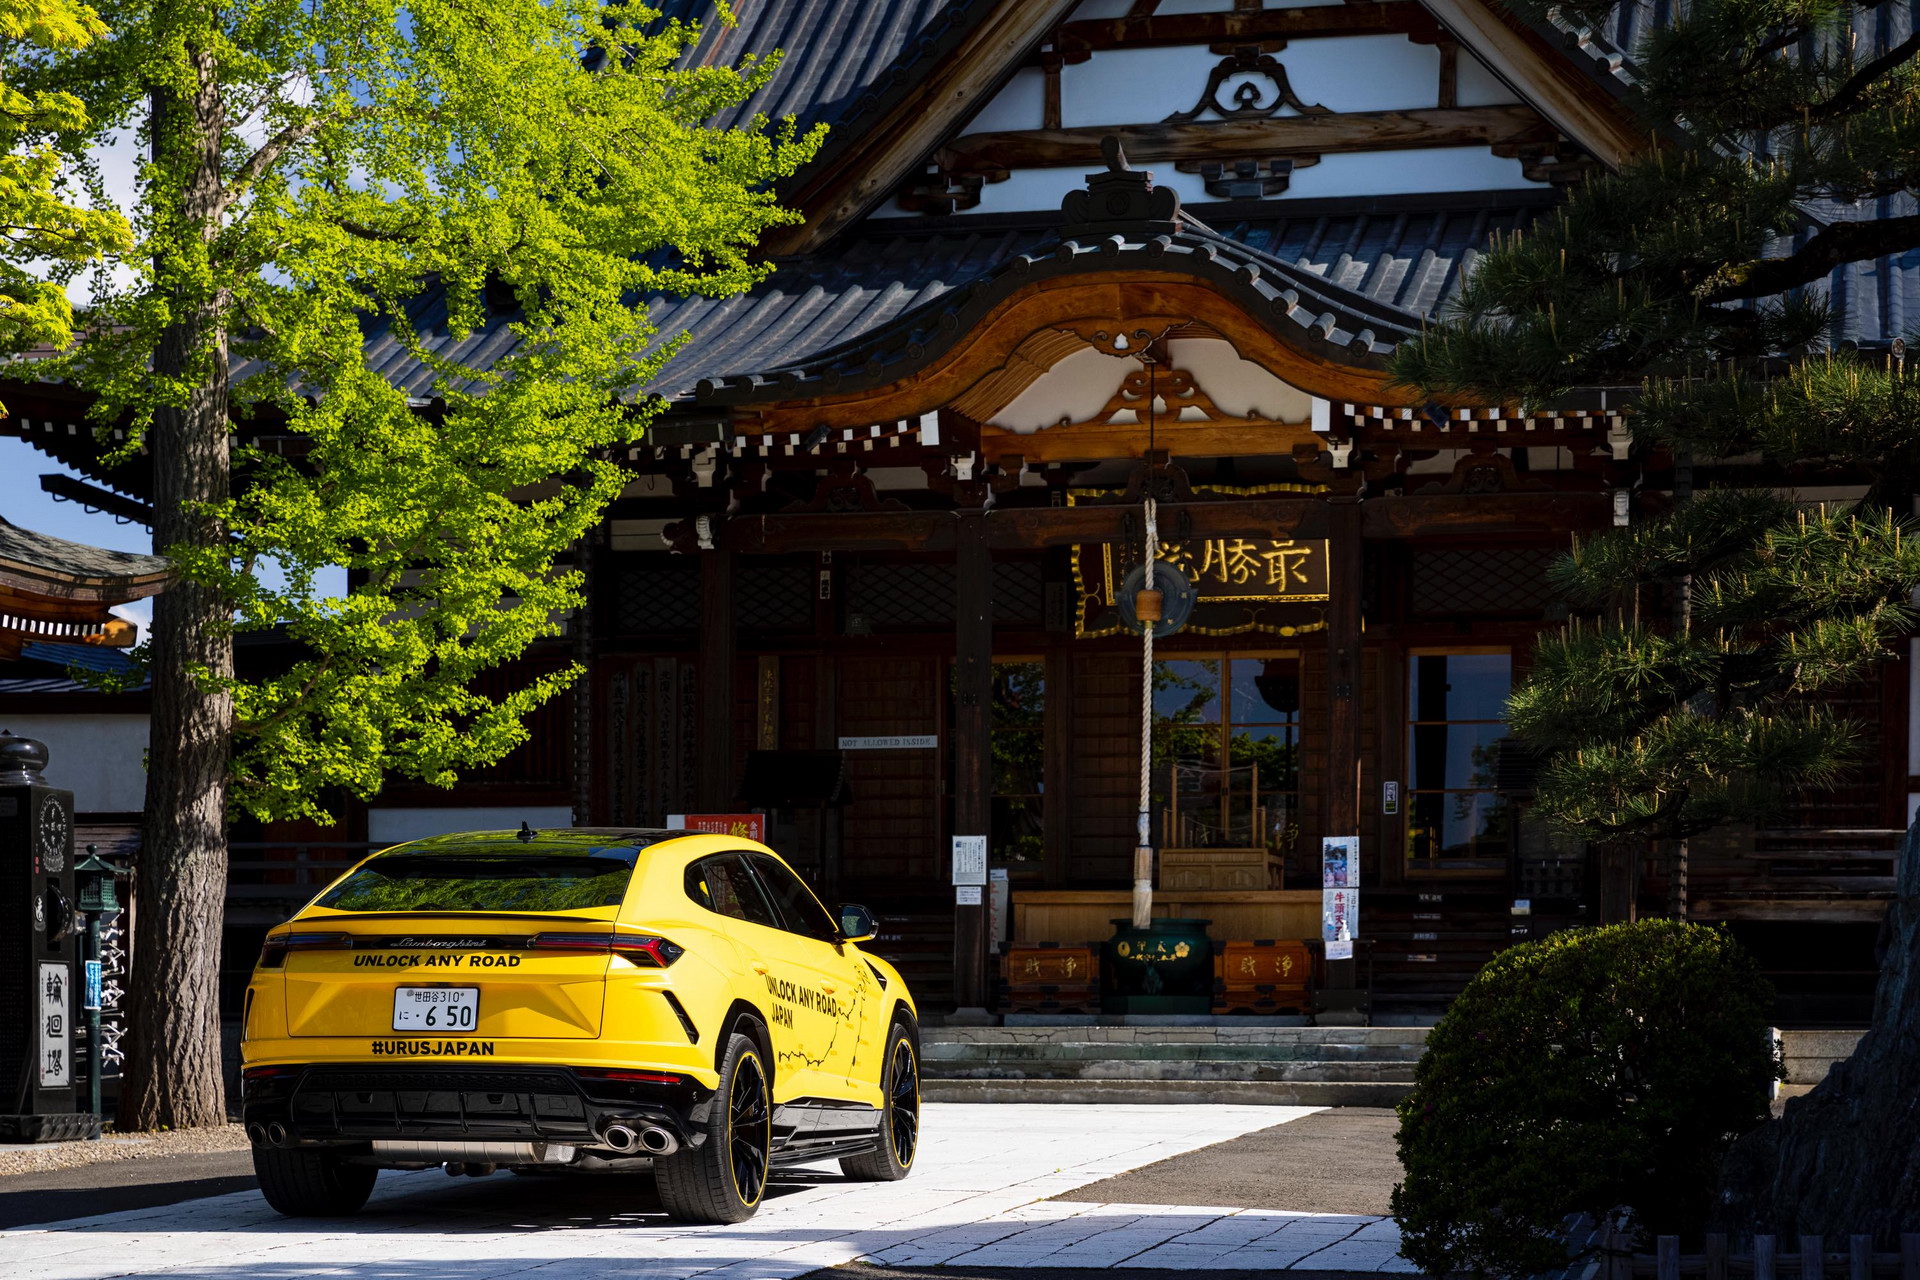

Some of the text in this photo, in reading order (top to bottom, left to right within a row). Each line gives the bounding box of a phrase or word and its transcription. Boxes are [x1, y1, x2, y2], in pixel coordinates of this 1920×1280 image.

[842, 738, 931, 747] NOT ALLOWED INSIDE
[388, 937, 487, 949] Lamborghini
[354, 955, 521, 967] UNLOCK ANY ROAD
[765, 973, 837, 1018] UNLOCK ANY ROAD
[771, 1002, 794, 1030] JAPAN
[371, 1040, 495, 1056] #URUSJAPAN
